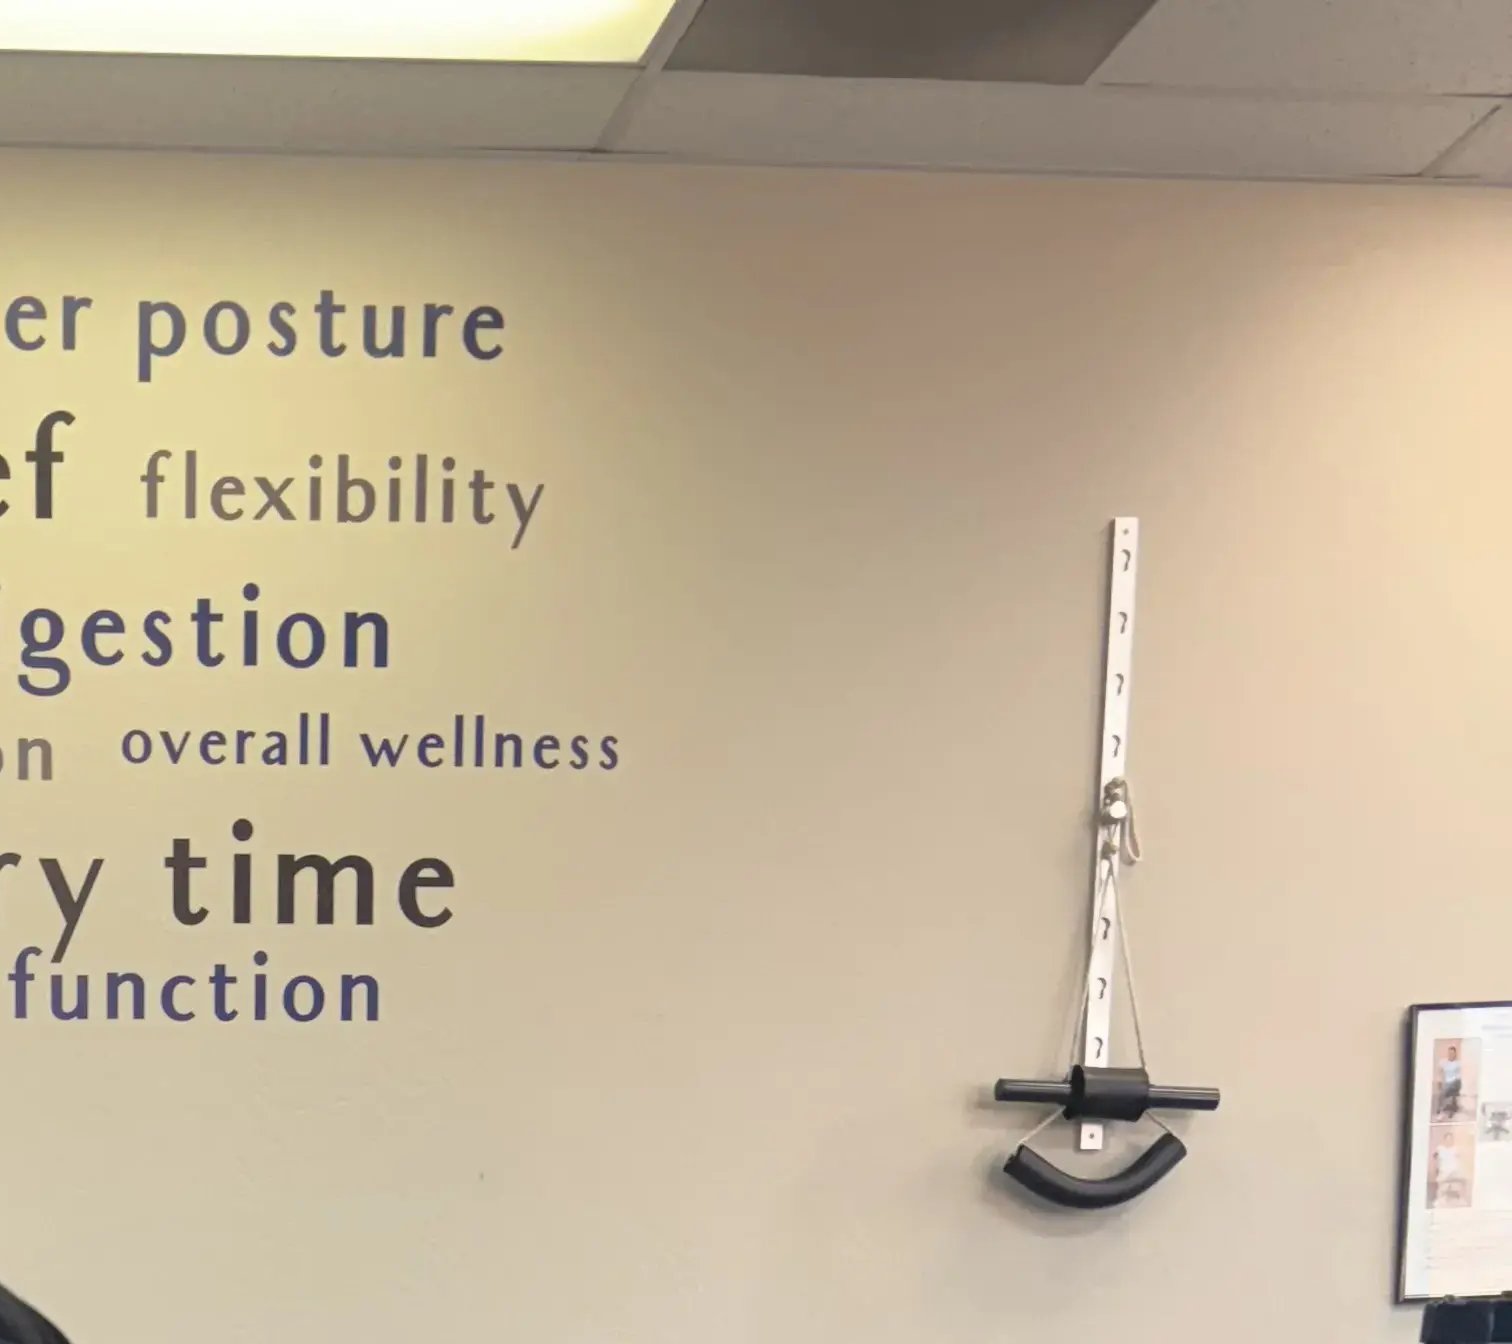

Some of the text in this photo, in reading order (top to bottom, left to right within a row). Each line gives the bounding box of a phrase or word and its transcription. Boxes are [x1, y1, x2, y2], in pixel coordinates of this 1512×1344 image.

[138, 290, 504, 382] posture
[140, 450, 544, 549] flexibility
[122, 712, 618, 770] overall wellness
[164, 818, 455, 928] time
[8, 946, 379, 1022] function
